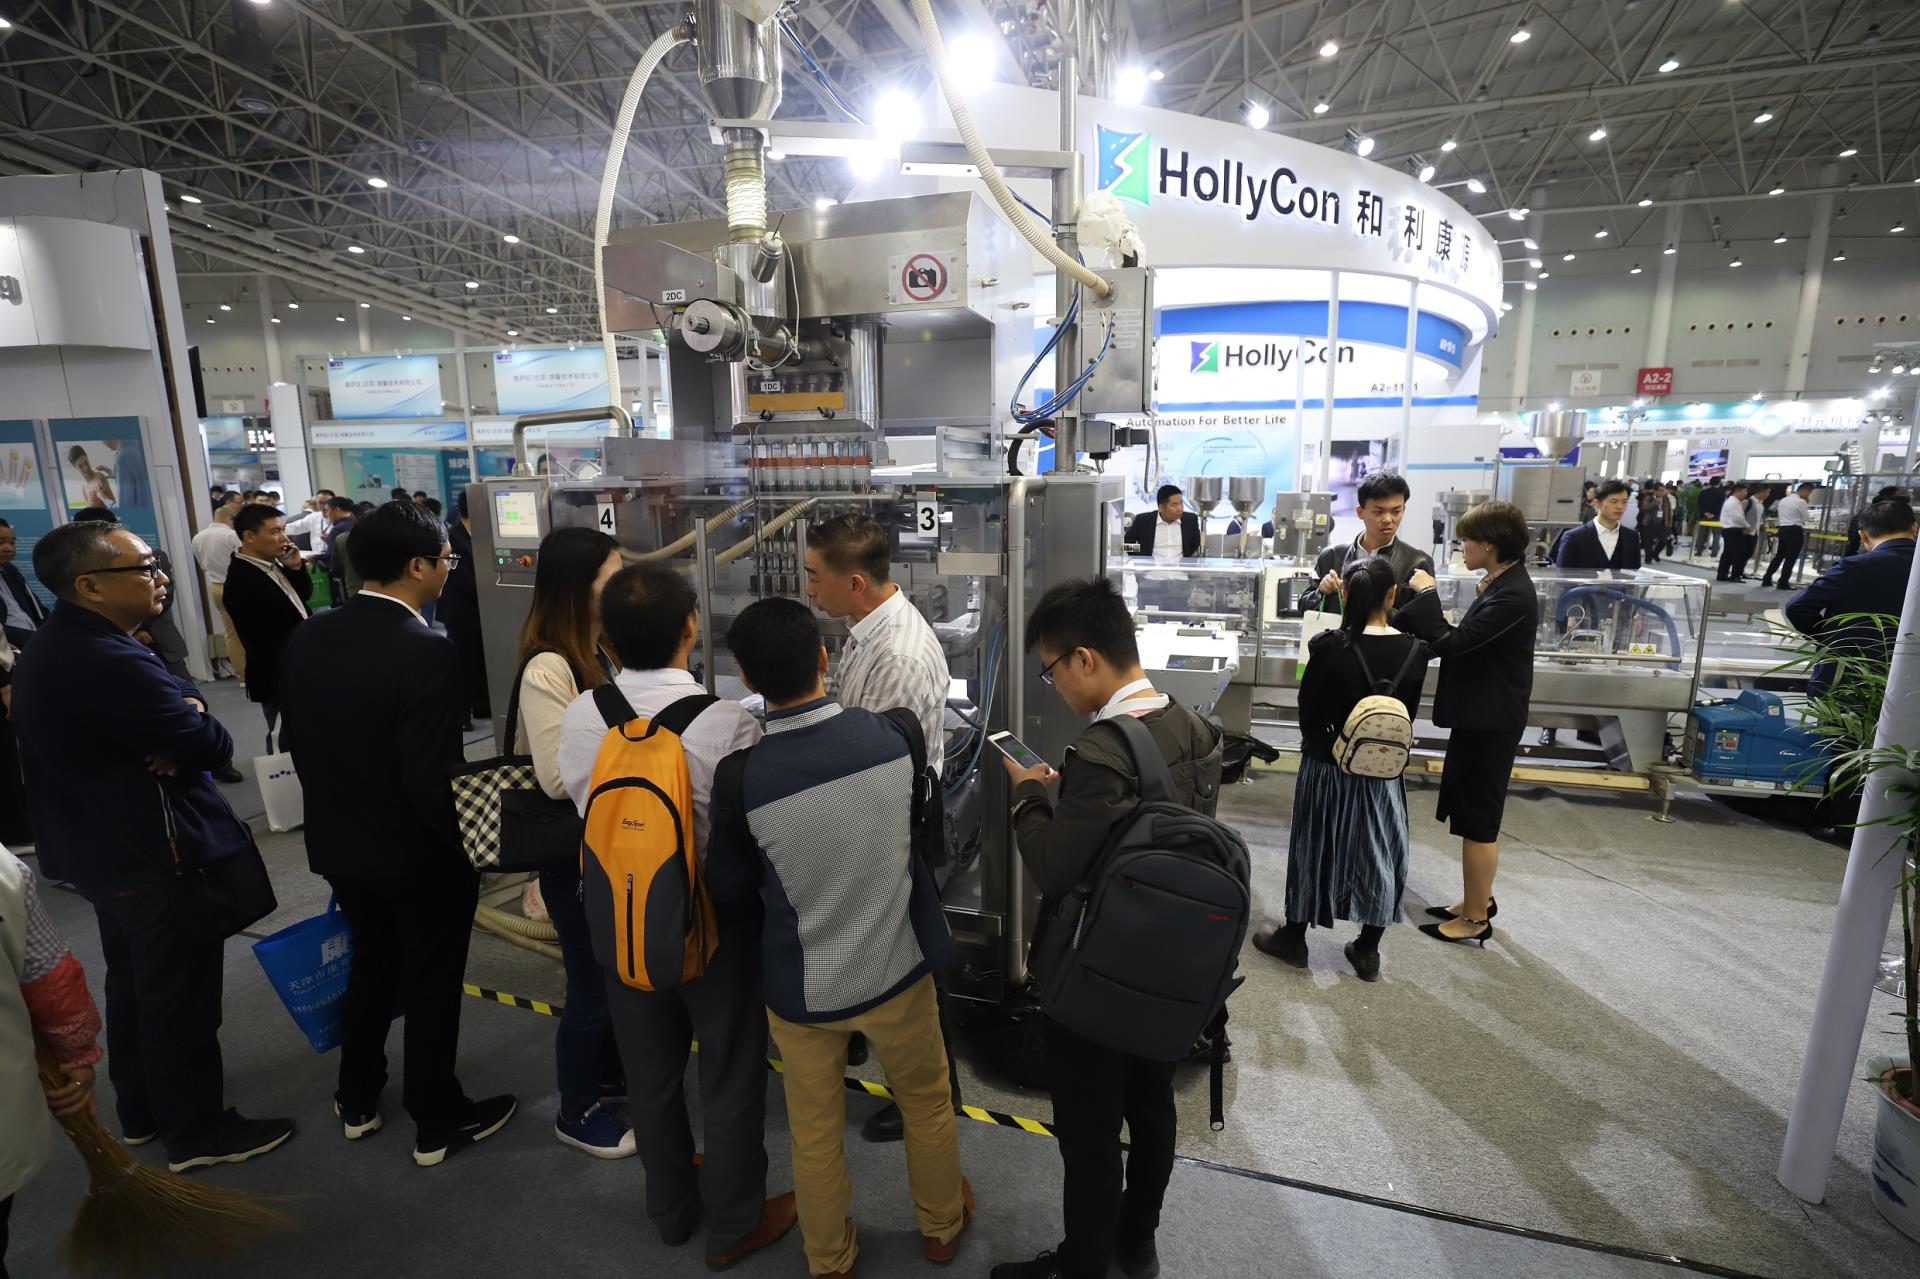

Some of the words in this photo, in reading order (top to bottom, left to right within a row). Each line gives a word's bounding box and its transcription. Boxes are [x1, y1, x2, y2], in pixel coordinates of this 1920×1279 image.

[1159, 147, 1340, 224] HollyCon
[665, 291, 683, 301] 2DC
[1225, 340, 1355, 371] HollyCon
[1642, 372, 1672, 384] A2-2
[1371, 382, 1419, 393] A2-111
[1127, 416, 1195, 428] Automation
[1199, 415, 1217, 426] For
[1223, 414, 1261, 425] Better
[1265, 413, 1287, 425] Life
[599, 508, 613, 529] 4
[919, 506, 936, 531] 3
